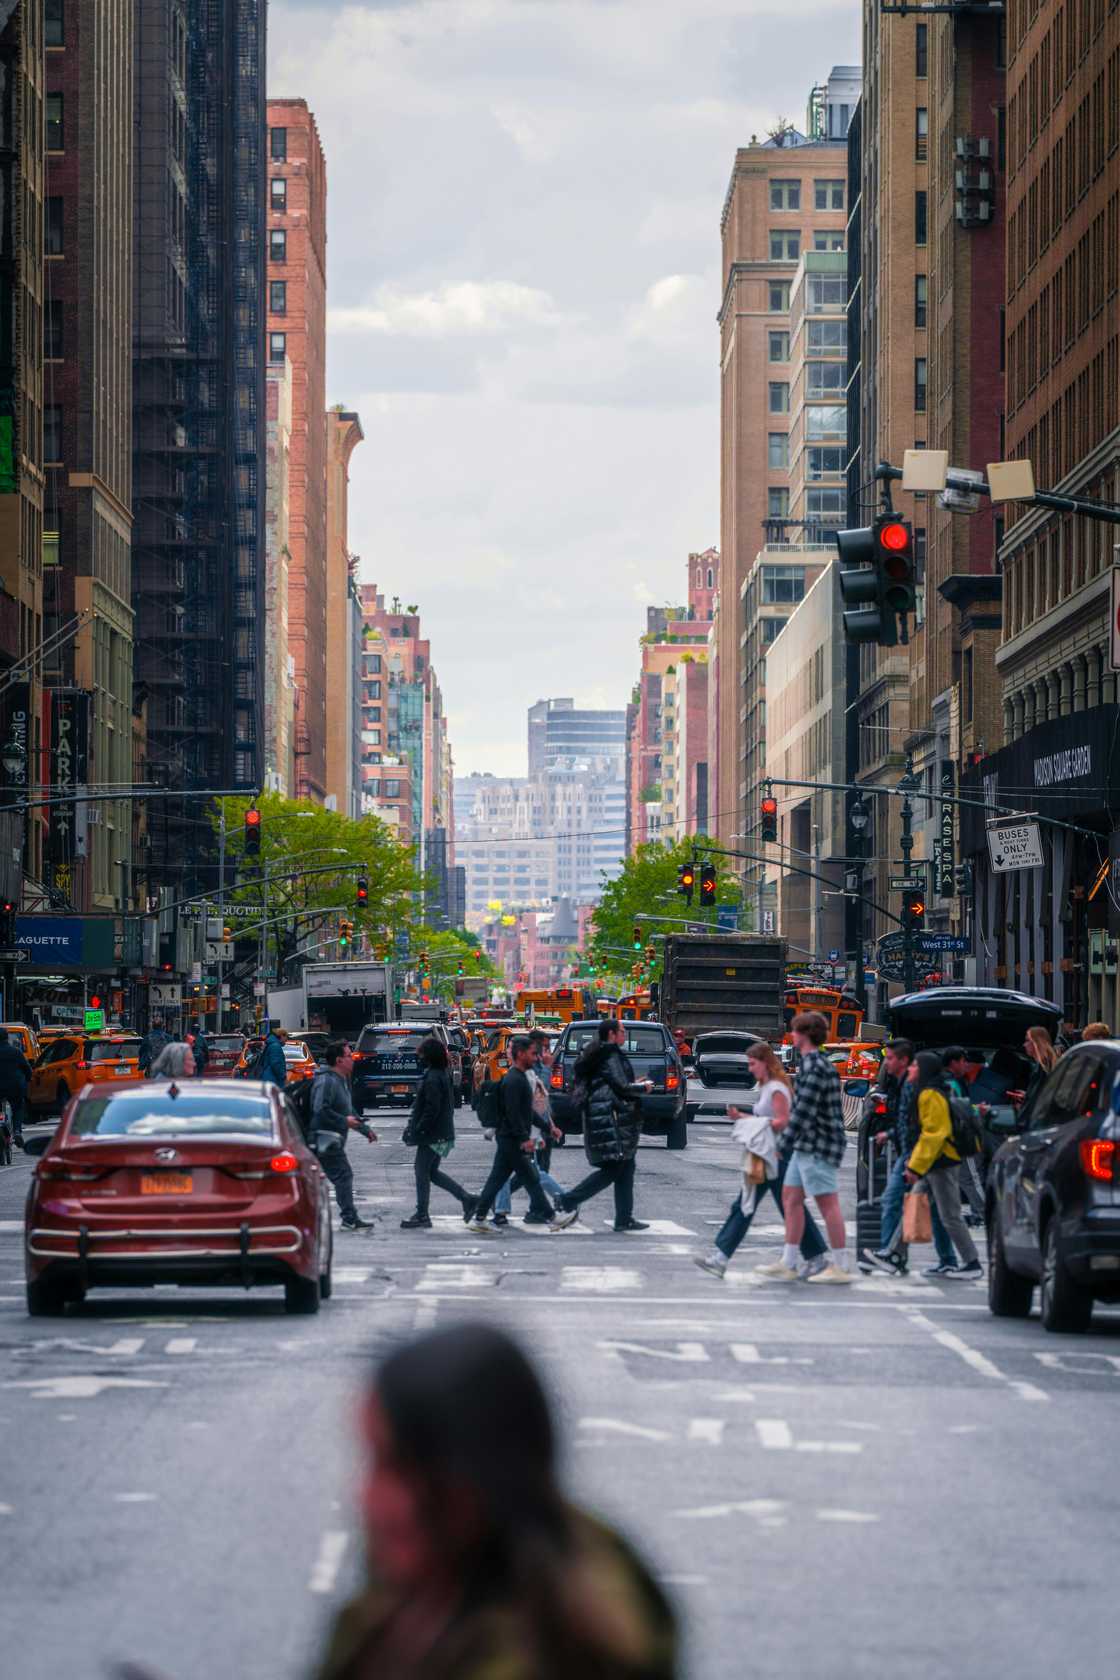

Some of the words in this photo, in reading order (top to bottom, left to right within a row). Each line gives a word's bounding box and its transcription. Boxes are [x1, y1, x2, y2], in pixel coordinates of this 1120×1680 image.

[1072, 744, 1091, 778] GARDEN
[997, 828, 1029, 841] BUSES
[1003, 843, 1027, 854] ONLY
[942, 852, 952, 883] SPA
[15, 936, 70, 945] AGUETTE
[921, 940, 941, 949] West
[956, 940, 965, 949] St
